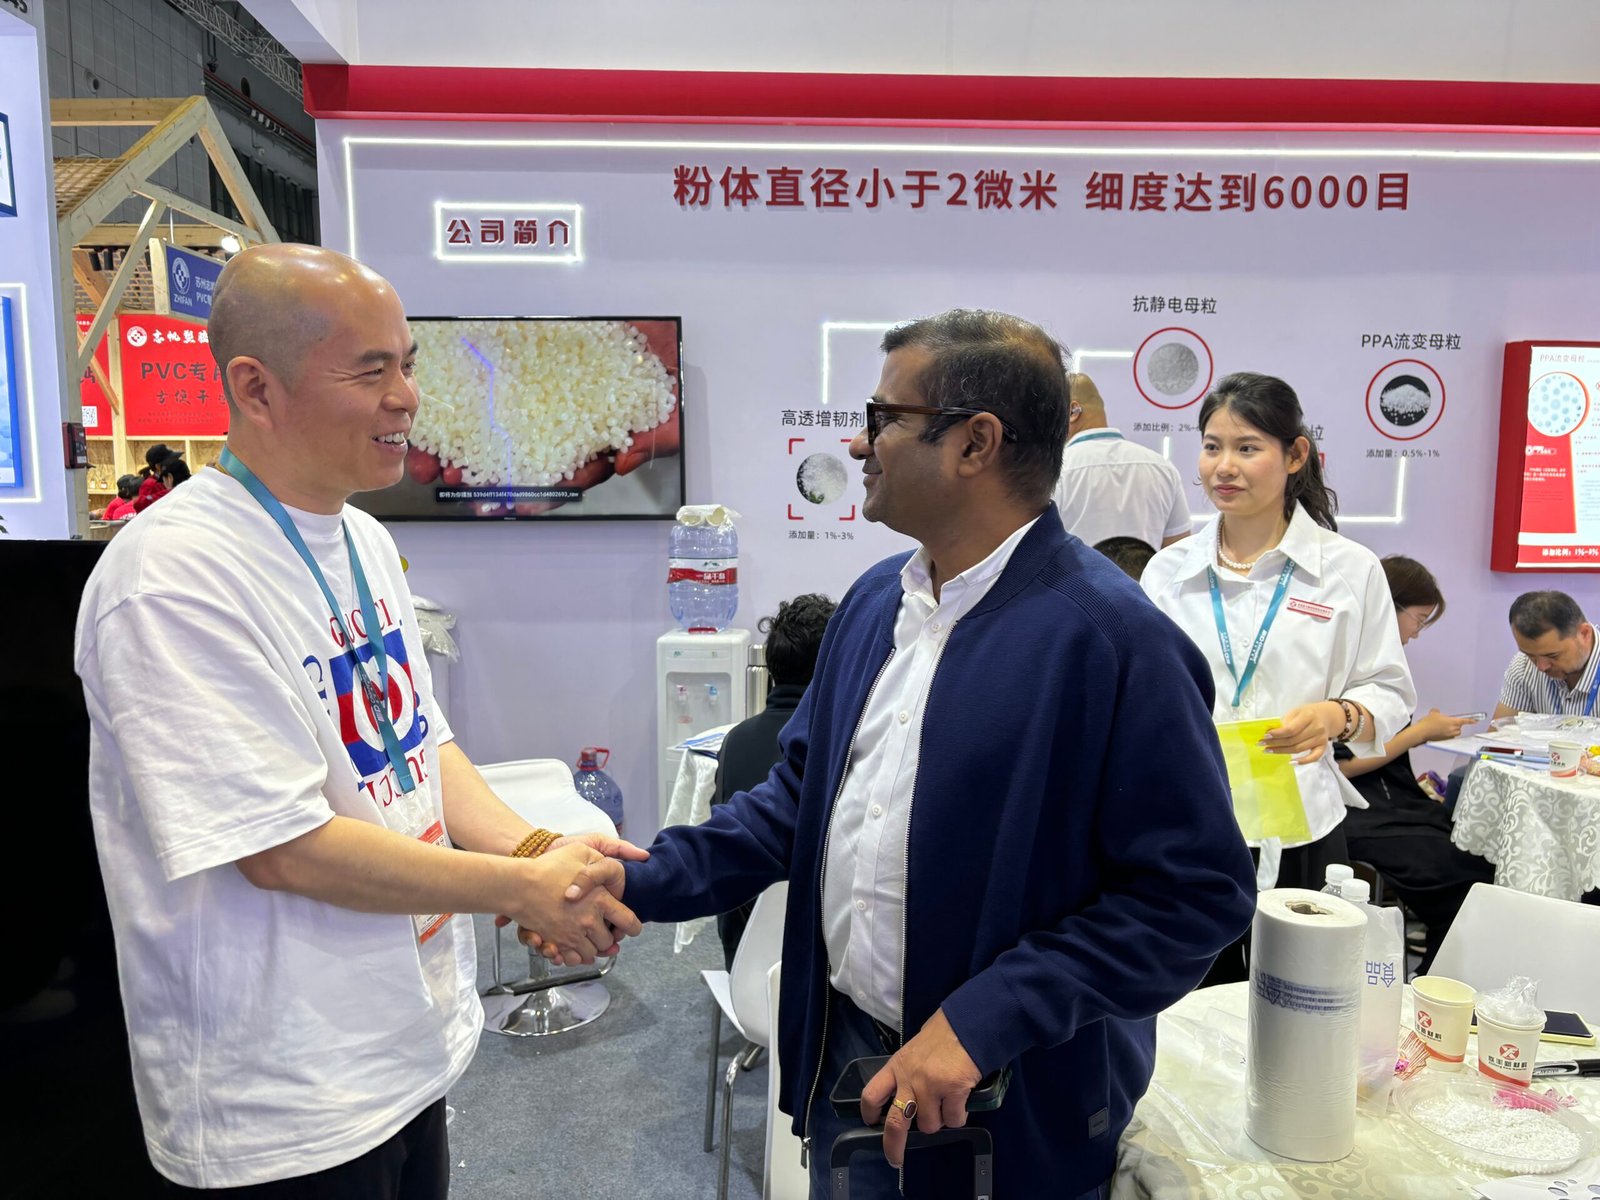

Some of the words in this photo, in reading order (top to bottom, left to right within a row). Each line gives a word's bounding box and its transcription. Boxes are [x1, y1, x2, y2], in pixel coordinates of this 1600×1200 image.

[673, 164, 1058, 210] 粉体直径小于2微米
[1084, 171, 1409, 212] 细度达到6000目
[446, 219, 570, 246] 公司简介
[1132, 295, 1217, 315] 抗静电母粒
[1361, 333, 1461, 350] PPA流变母粒
[781, 409, 866, 428] 高透增韧剂
[1365, 960, 1397, 988] 食品
